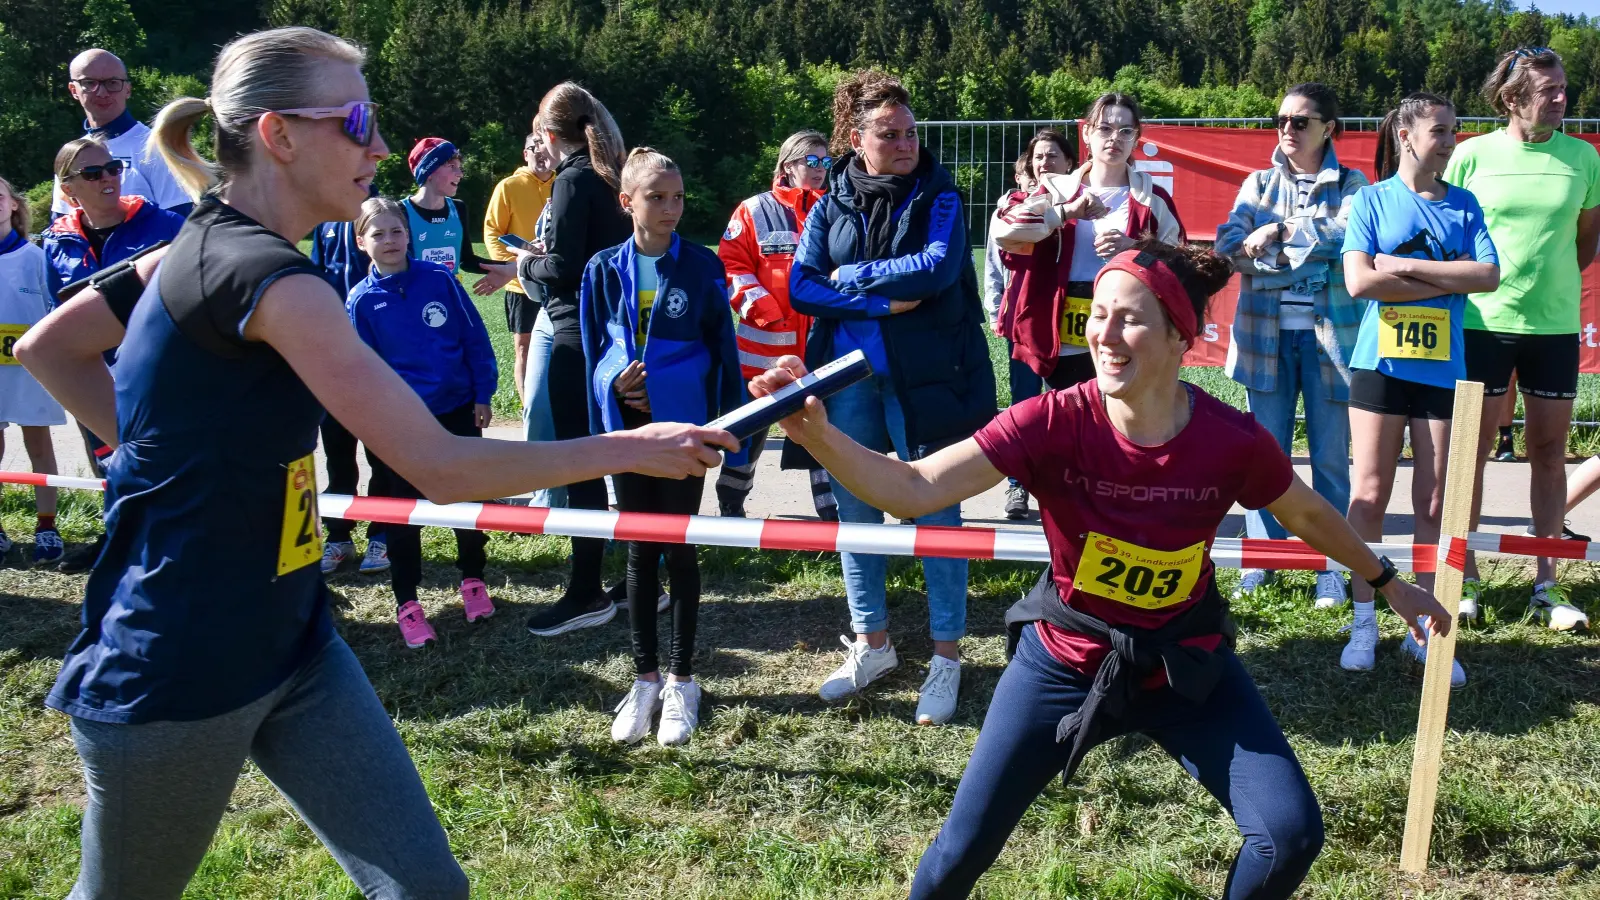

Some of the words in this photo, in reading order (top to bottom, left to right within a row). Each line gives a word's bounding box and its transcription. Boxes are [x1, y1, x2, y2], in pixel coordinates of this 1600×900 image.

[424, 253, 455, 263] Arabella
[1409, 313, 1446, 322] Landkreislauf
[1392, 321, 1438, 350] 146
[1096, 480, 1220, 502] SPORTIVA
[294, 488, 319, 548] 2
[1118, 550, 1134, 560] 39.
[1135, 553, 1197, 567] Landkreislauf
[1095, 556, 1183, 599] 203
